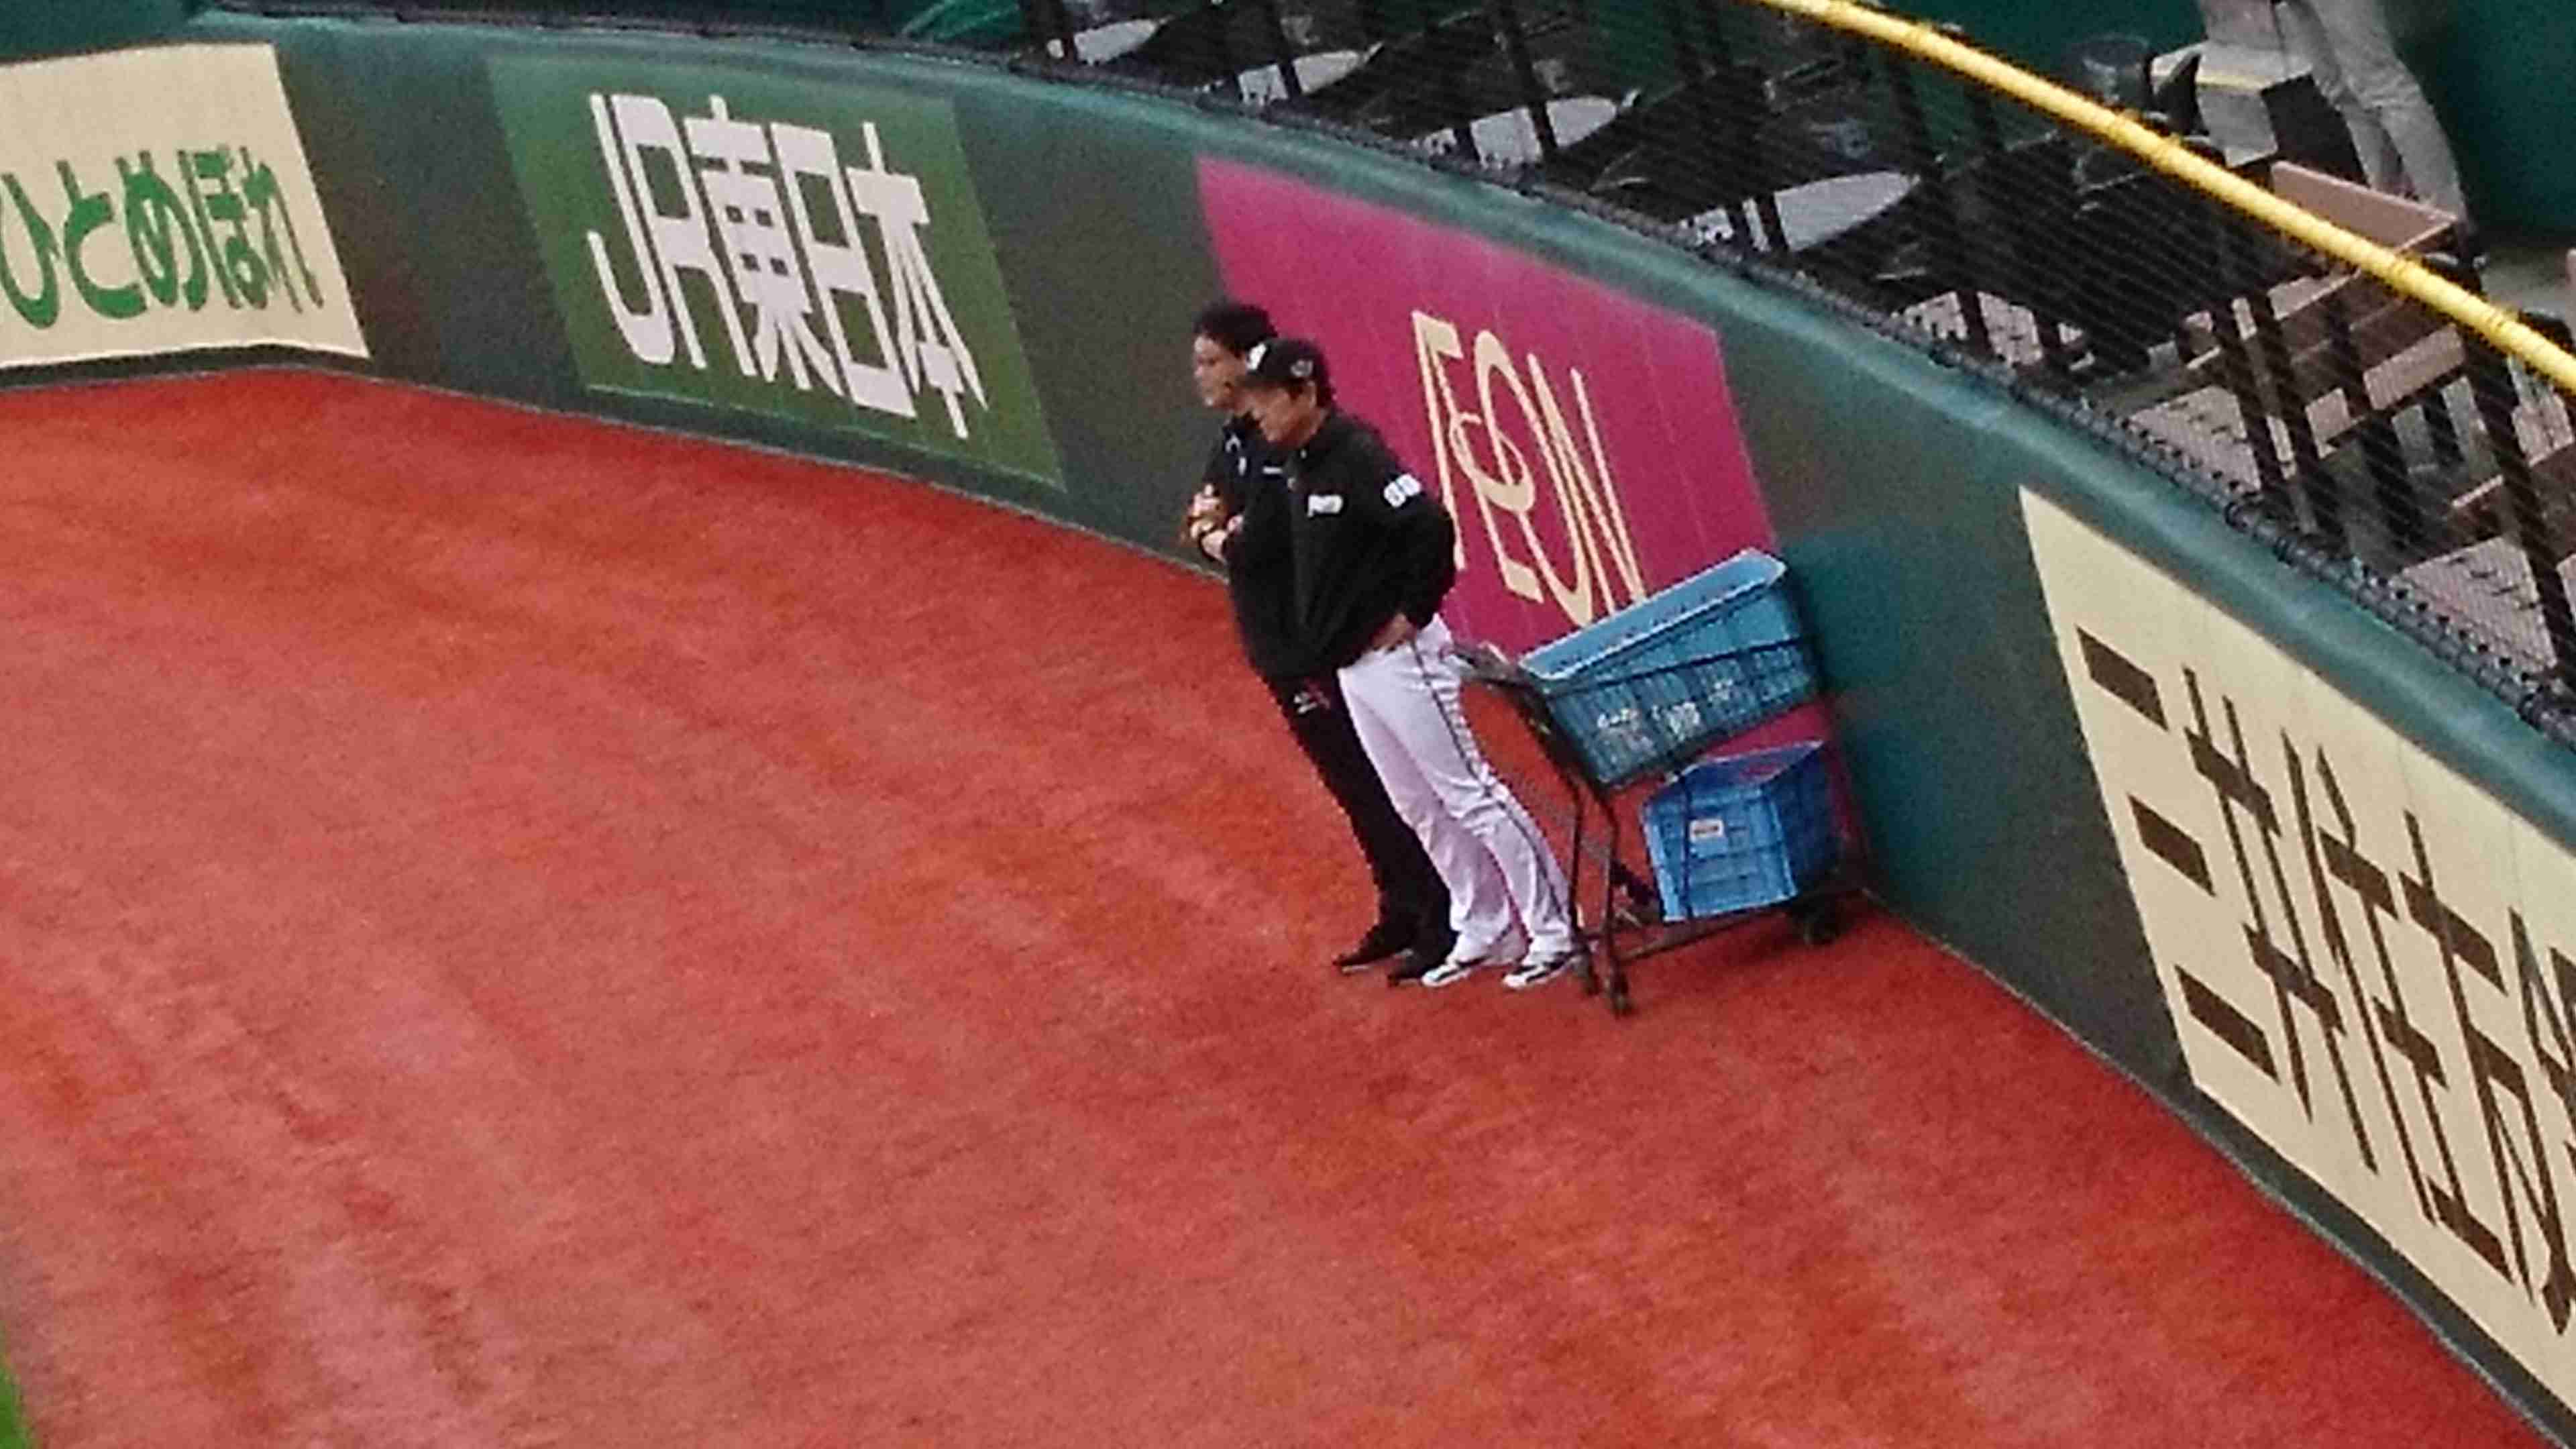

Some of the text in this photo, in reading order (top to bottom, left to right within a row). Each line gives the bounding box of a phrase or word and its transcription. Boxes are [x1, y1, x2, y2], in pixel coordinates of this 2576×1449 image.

[0, 144, 324, 329] ひとめぼれ
[587, 93, 987, 439] JR東日本
